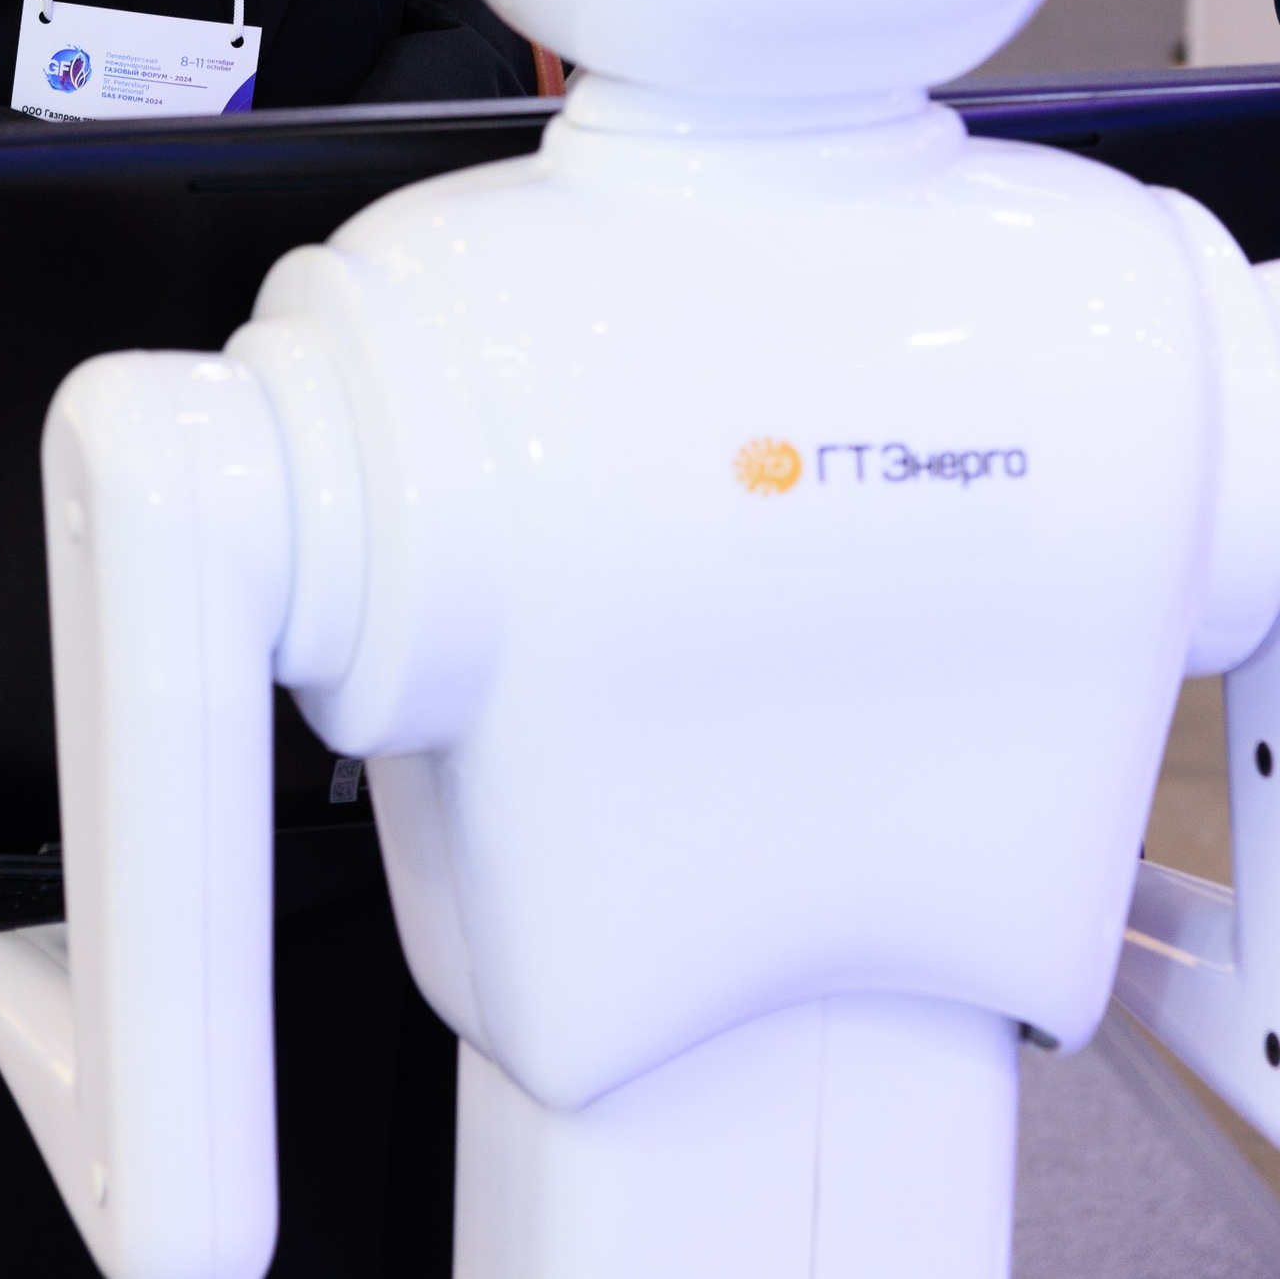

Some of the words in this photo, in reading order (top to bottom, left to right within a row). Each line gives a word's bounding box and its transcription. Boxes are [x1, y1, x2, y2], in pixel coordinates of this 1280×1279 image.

[106, 52, 158, 64] Петербургский
[206, 59, 235, 67] октября
[105, 60, 161, 71] международный
[104, 66, 139, 76] ГАЗОВЫЙ
[140, 71, 168, 80] ФОРУМ
[174, 75, 192, 83] 2024
[102, 84, 144, 95] International
[113, 79, 150, 90] Petersburg
[101, 92, 116, 100] GAS
[117, 94, 144, 103] FORUM
[145, 97, 163, 105] 2024
[21, 105, 42, 116] ООО
[44, 109, 80, 123] Газпром
